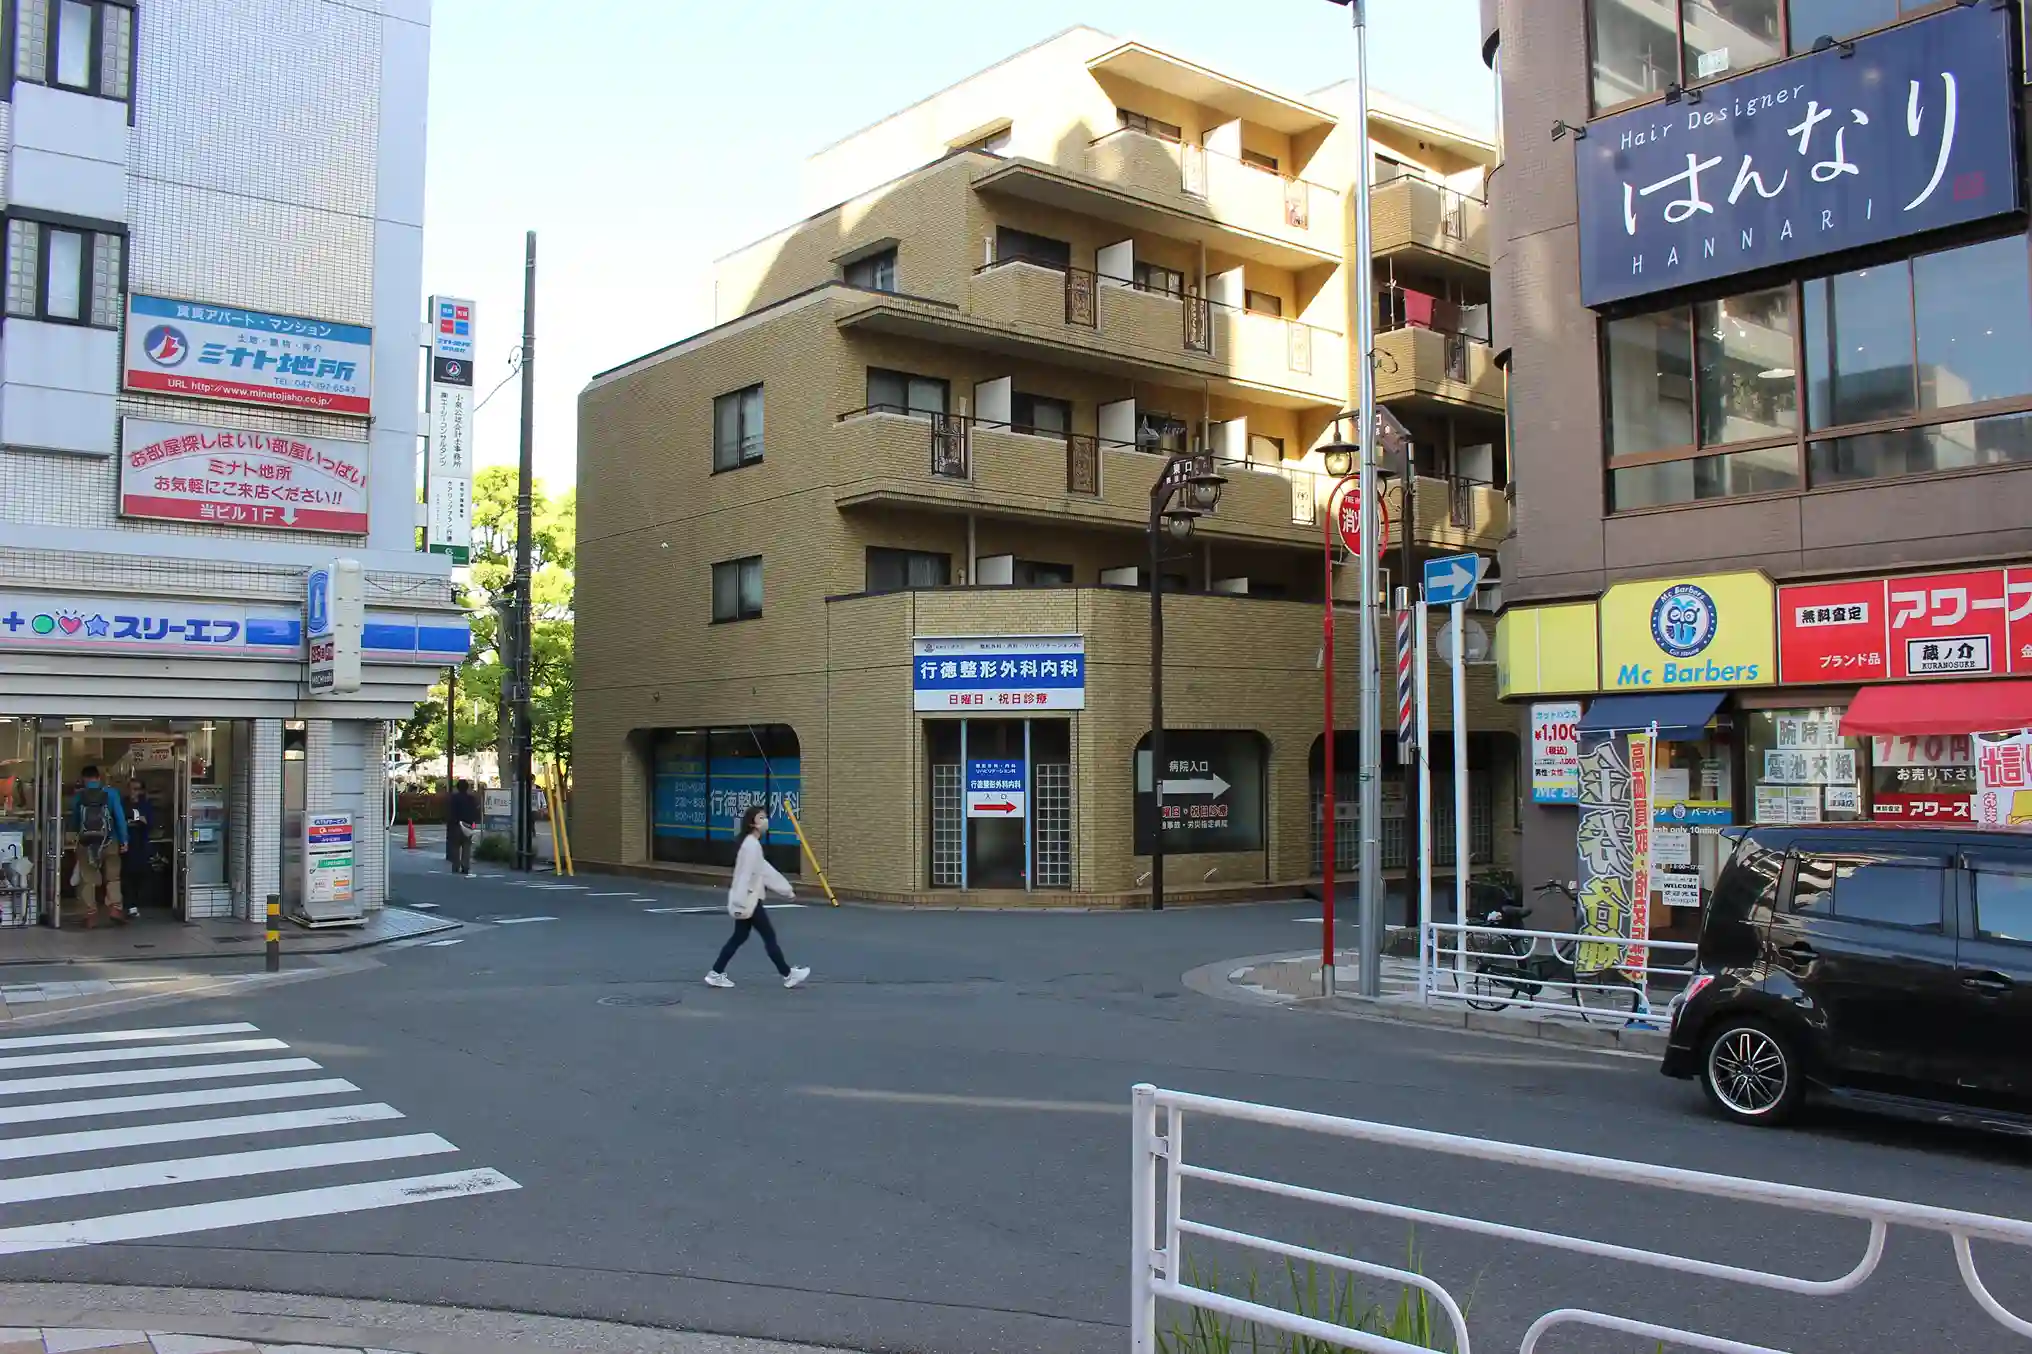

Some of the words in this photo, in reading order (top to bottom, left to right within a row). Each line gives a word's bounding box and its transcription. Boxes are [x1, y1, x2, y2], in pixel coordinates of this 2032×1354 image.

[1620, 121, 1673, 151] Hair
[1688, 84, 1805, 131] Designer
[1623, 71, 1957, 236] はんなり
[1632, 199, 1872, 275] HANNARI
[176, 304, 332, 337] 賃貸アパート・マンション
[198, 342, 356, 382] ミナト地所
[167, 379, 188, 390] URL
[191, 381, 333, 406] http://www.minatojisho.co.jp/
[131, 433, 366, 489] お部屋探しはいい部屋いっぱい
[207, 459, 292, 481] ミナト地所
[154, 476, 343, 505] お気軽にご来店ください!!
[200, 504, 246, 520] 当ビル
[252, 506, 274, 521] 1F
[1801, 606, 1862, 624] 無料査定
[113, 615, 240, 643] スリーエフ
[1820, 652, 1881, 668] ブランド品
[1922, 643, 1974, 661] 蔵ノ介
[920, 659, 1079, 680] 行徳整形外科内科
[1617, 664, 1652, 685] Mc
[1663, 659, 1759, 683] Barbers
[1922, 660, 1976, 669] KURANOSUKE
[949, 692, 1048, 705] 日曜日・祝日診療
[1169, 761, 1208, 772] 病院入口
[1769, 752, 1853, 780] 電池交換
[970, 780, 1021, 789] 行徳整形外科内科
[1910, 802, 1968, 816] アワーズ
